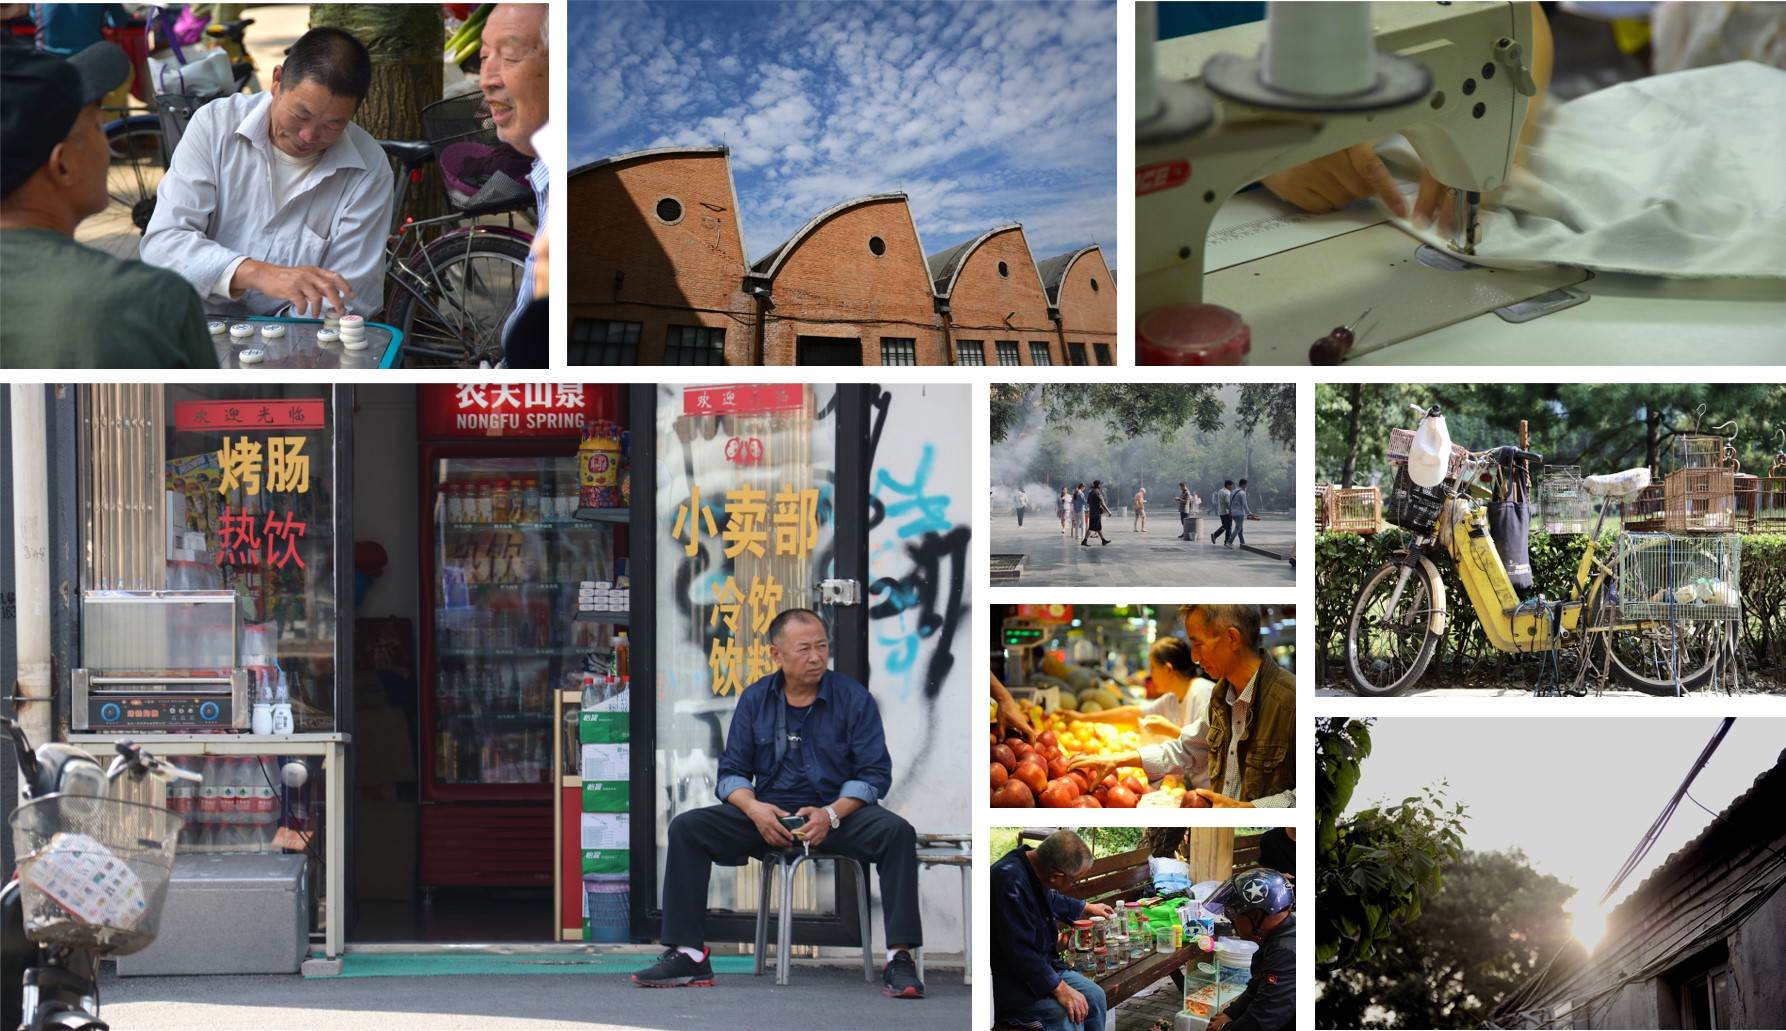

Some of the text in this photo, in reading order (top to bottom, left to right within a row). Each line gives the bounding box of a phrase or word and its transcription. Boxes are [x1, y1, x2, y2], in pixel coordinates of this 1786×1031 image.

[193, 405, 305, 424] 欢迎光临
[456, 412, 585, 430] NONGFU SPRING
[216, 436, 310, 495] 烤肠
[215, 506, 306, 569] 热饮
[671, 483, 820, 559] 小卖部
[709, 575, 784, 635] 冷饮
